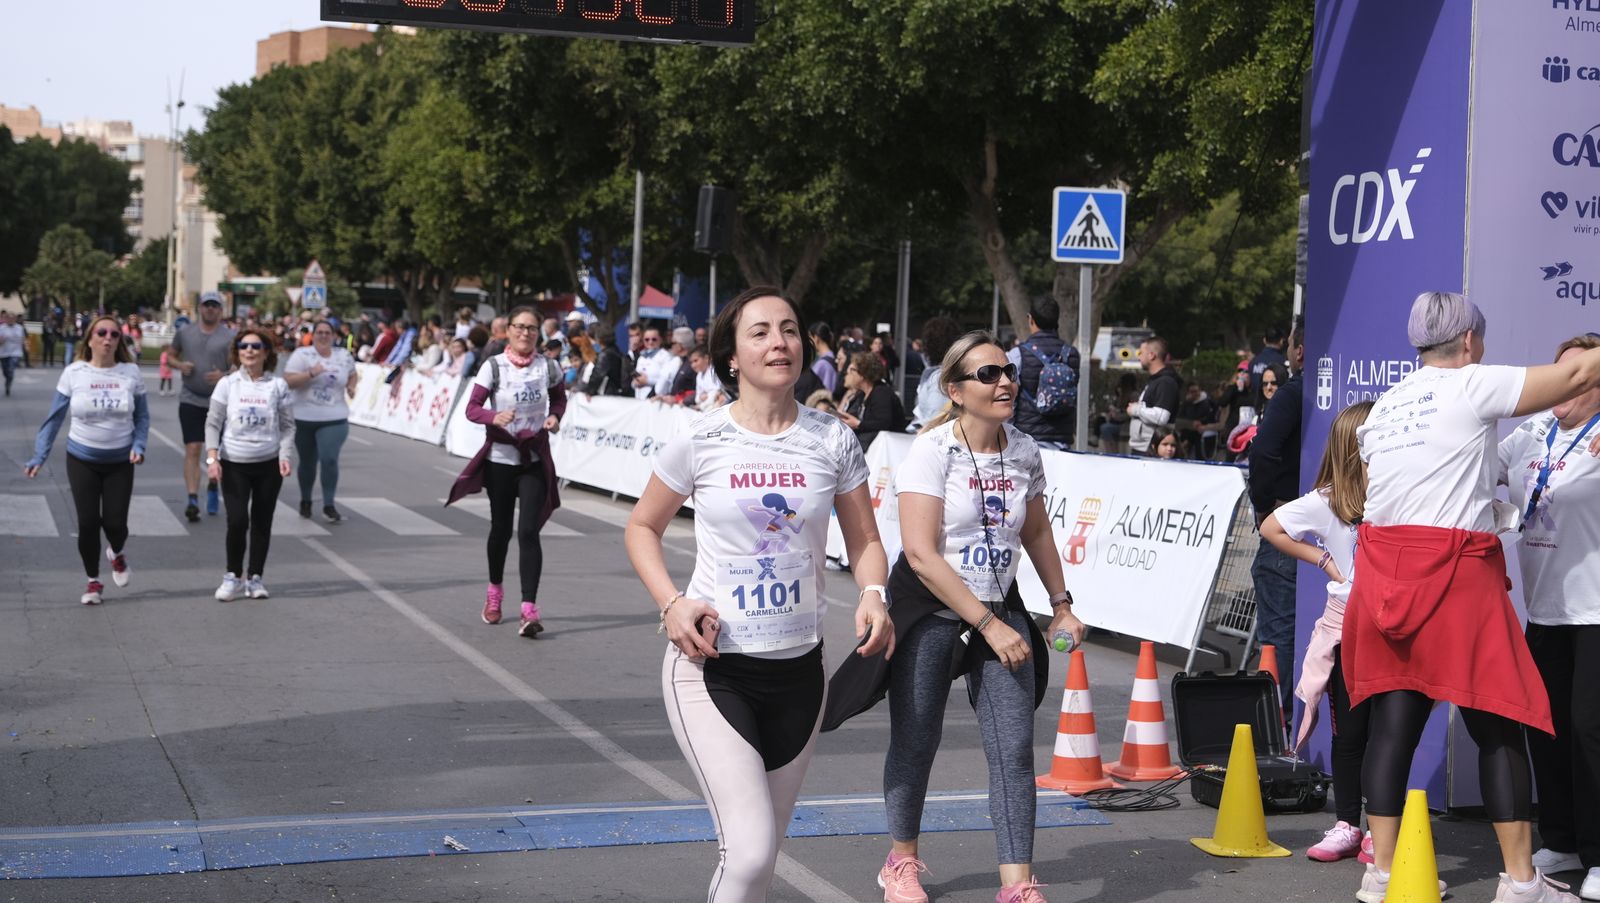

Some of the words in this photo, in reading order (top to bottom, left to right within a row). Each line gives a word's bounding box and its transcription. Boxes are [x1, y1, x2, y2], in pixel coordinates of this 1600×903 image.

[1577, 66, 1600, 82] ca
[1329, 148, 1431, 245] CDX
[1573, 224, 1592, 234] vivir
[1593, 226, 1600, 236] p
[1556, 281, 1600, 306] aqu
[92, 398, 120, 409] 1127
[513, 390, 542, 402] 1205
[733, 463, 774, 471] CARRERA
[730, 472, 807, 489] MUJER
[969, 476, 1014, 492] MUJER
[1110, 504, 1216, 549] ALMERÍA
[959, 545, 1012, 568] 1099
[1106, 543, 1158, 571] CIUDAD
[732, 579, 801, 610] 1101
[745, 606, 793, 617] CARMELILLA
